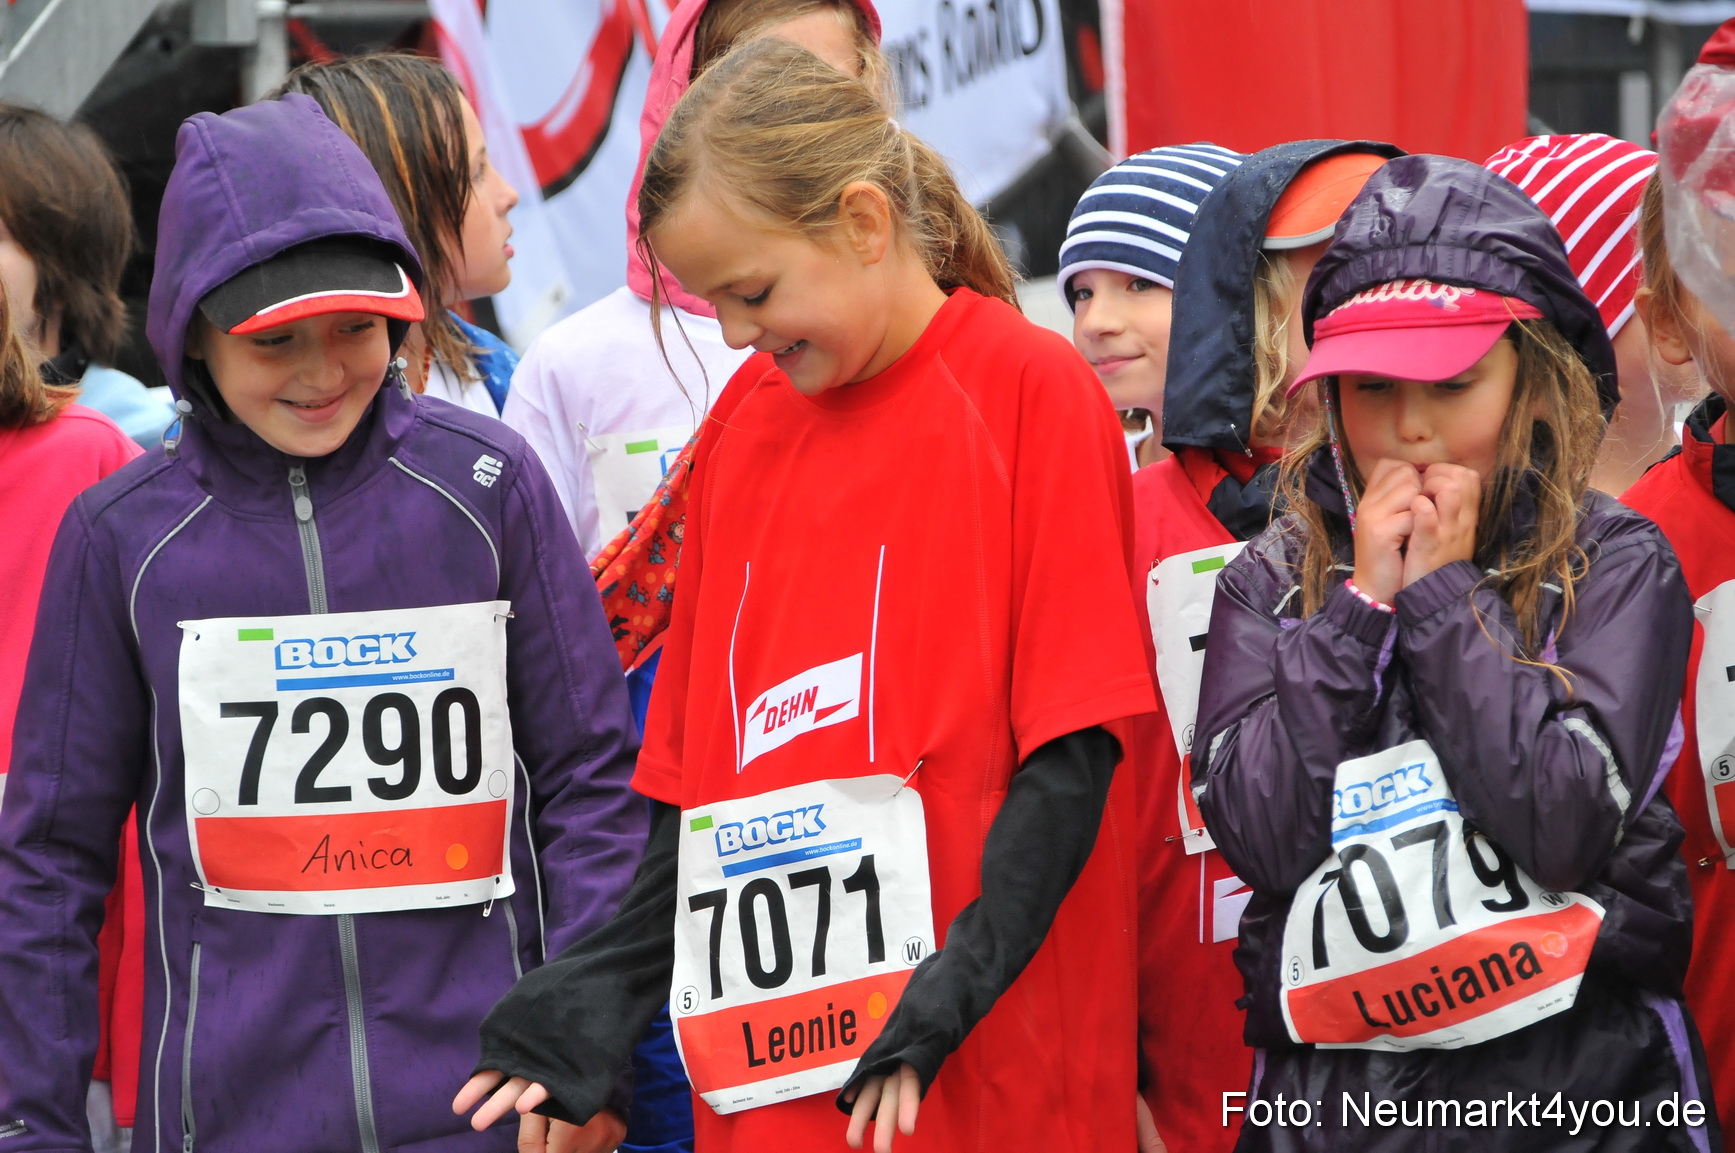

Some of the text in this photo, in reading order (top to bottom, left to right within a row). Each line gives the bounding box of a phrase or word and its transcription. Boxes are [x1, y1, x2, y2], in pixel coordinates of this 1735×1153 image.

[275, 632, 417, 670] BOCK
[392, 671, 450, 681] www.bockonline.de
[763, 685, 819, 735] DEHN
[220, 687, 483, 806] 7290
[1719, 760, 1730, 776] 5
[715, 803, 827, 857] BOCK
[805, 841, 857, 855] www.bockonline.de
[301, 834, 413, 874] Anica
[1312, 819, 1530, 970] 7079
[688, 854, 886, 1000] 7071
[906, 941, 921, 961] W
[1292, 963, 1299, 981] 5
[1353, 941, 1543, 1029] Luciana
[683, 991, 692, 1010] 5
[742, 1002, 857, 1068] Leonie
